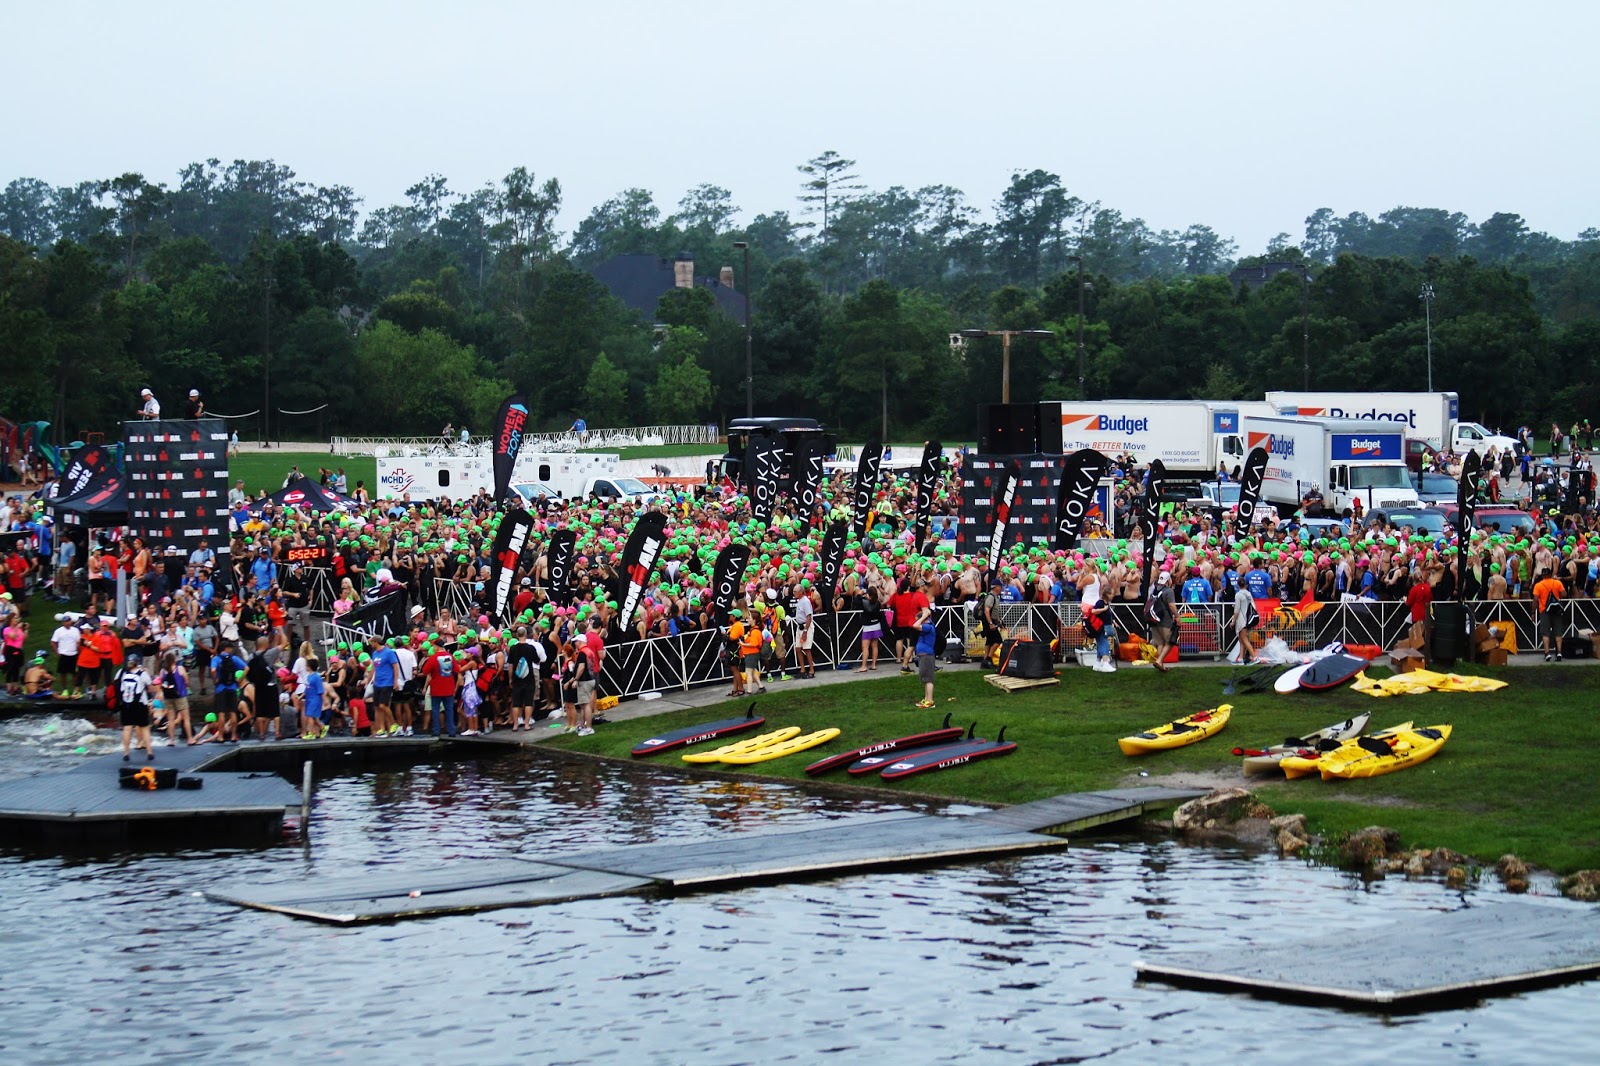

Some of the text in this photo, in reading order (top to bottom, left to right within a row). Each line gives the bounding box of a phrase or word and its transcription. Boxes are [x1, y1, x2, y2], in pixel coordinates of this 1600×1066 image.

[497, 407, 518, 454] WOMEN
[507, 410, 527, 459] FOR TRI
[1075, 441, 1090, 450] The
[1091, 441, 1122, 450] BETTER
[1123, 442, 1146, 451] Move
[1098, 414, 1149, 436] Budget
[1269, 433, 1295, 460] Budget
[1351, 438, 1381, 451] Budget
[381, 475, 404, 484] MCHD
[755, 451, 769, 518] ROKA
[799, 456, 821, 524] ROKA
[855, 456, 878, 526] ROKA
[1059, 466, 1099, 536] ROKA
[1237, 464, 1264, 536] ROKA
[716, 557, 742, 609] ROKA
[825, 537, 842, 587] ROKA
